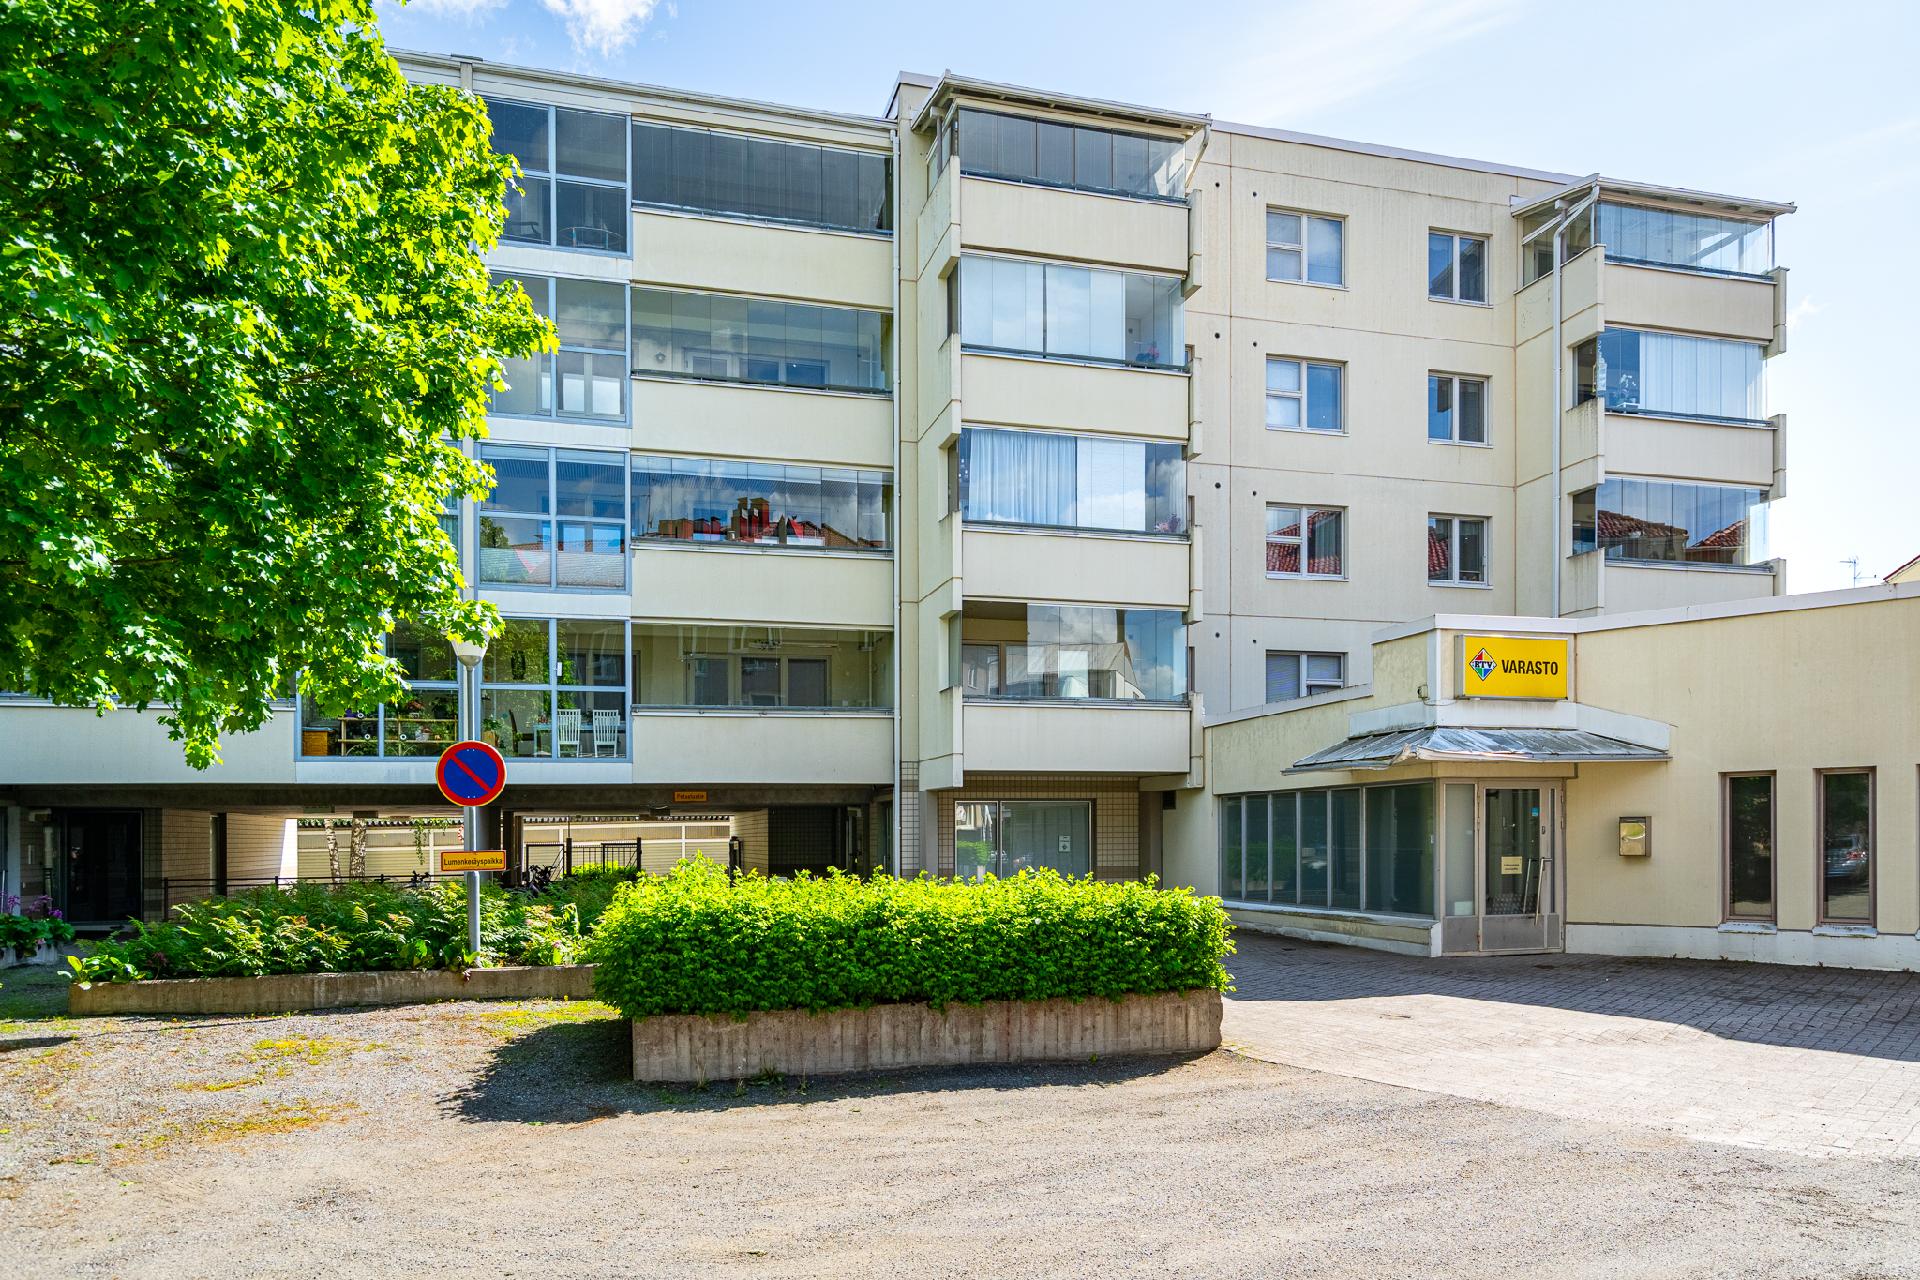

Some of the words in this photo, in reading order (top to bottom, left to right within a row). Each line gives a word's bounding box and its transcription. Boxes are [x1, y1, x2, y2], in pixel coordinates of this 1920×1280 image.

[1474, 660, 1493, 668] RTV
[1501, 659, 1558, 675] VARASTO
[443, 857, 503, 866] Lumenkeräyspaikka
